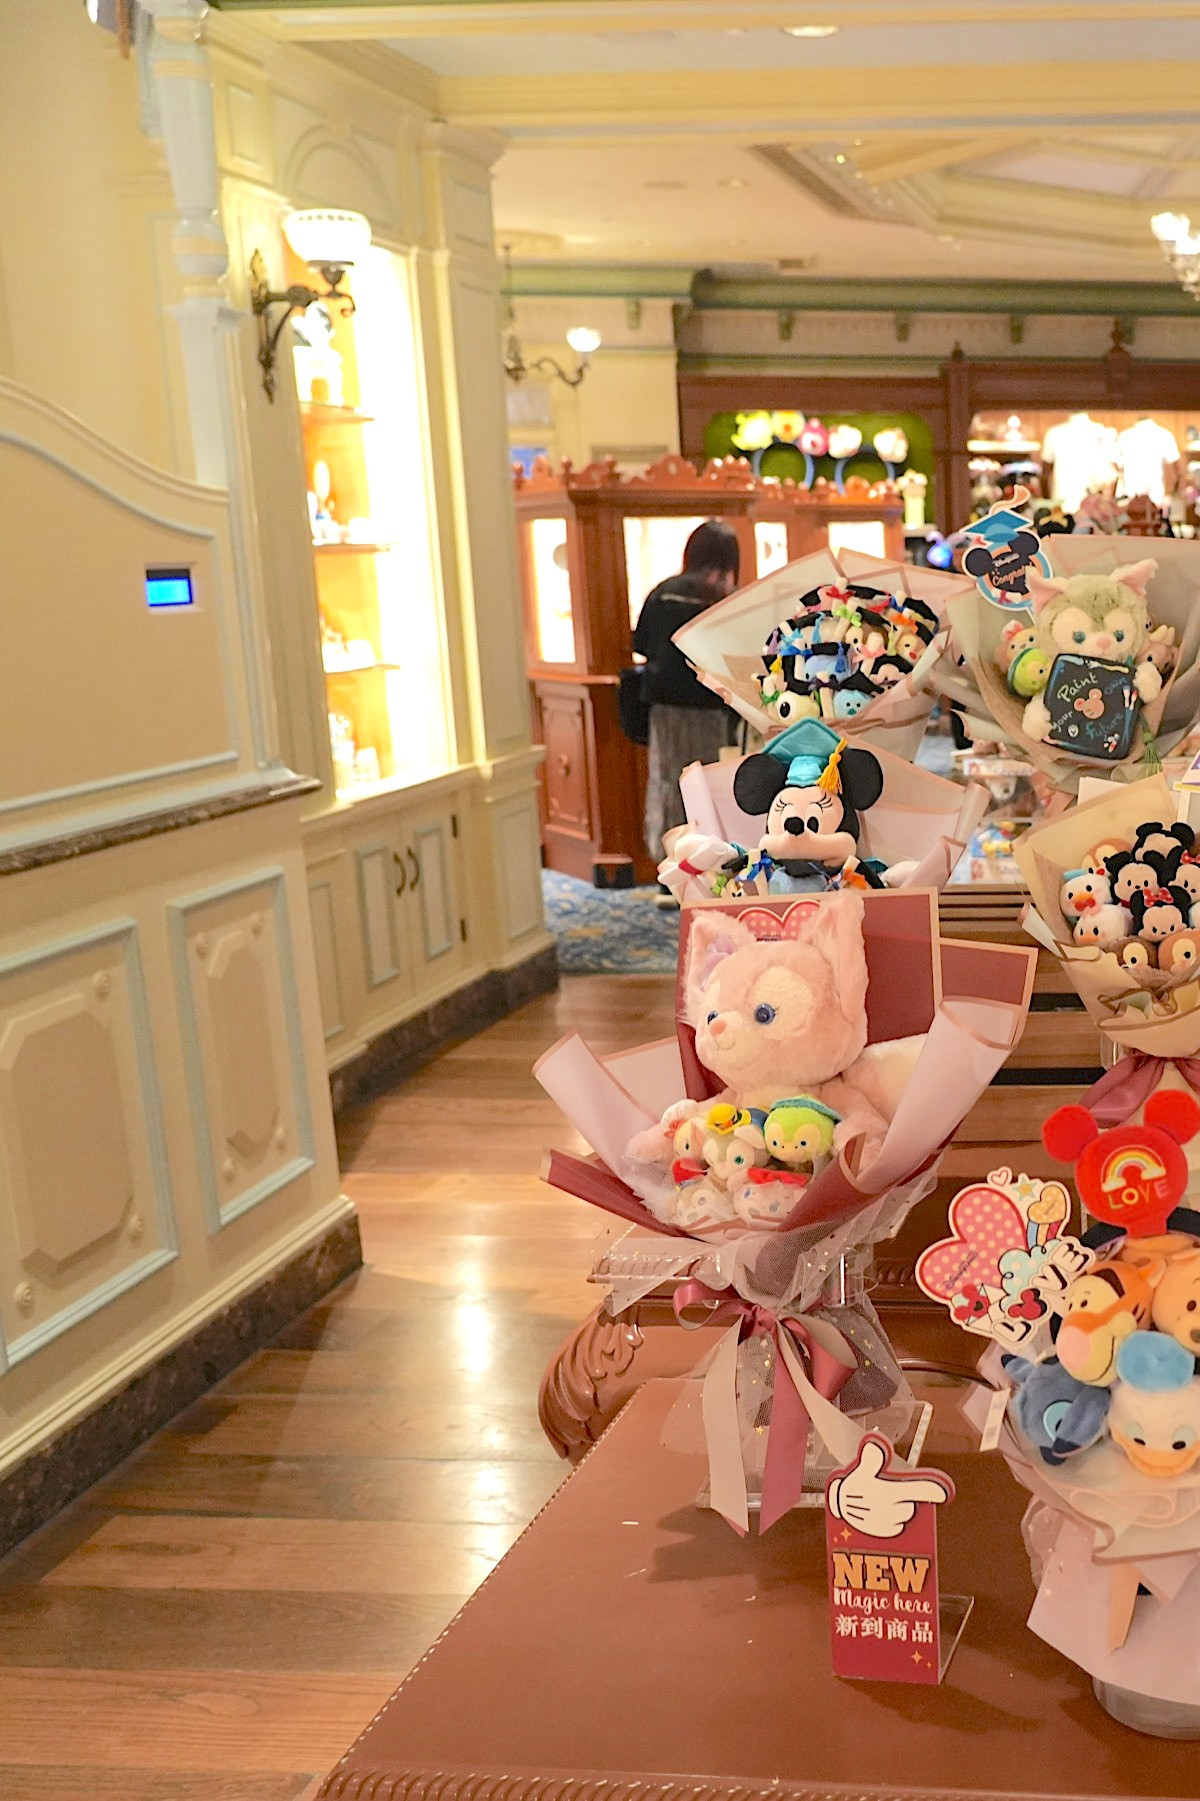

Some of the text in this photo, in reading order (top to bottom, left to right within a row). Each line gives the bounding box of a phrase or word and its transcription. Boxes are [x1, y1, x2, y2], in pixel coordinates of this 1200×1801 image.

[993, 565, 1026, 586] Congrat
[1057, 672, 1098, 702] Paint
[1108, 1179, 1171, 1209] LOVE
[832, 1552, 930, 1594] NEW
[833, 1587, 933, 1615] Magic here
[835, 1614, 934, 1644] 新到商品
